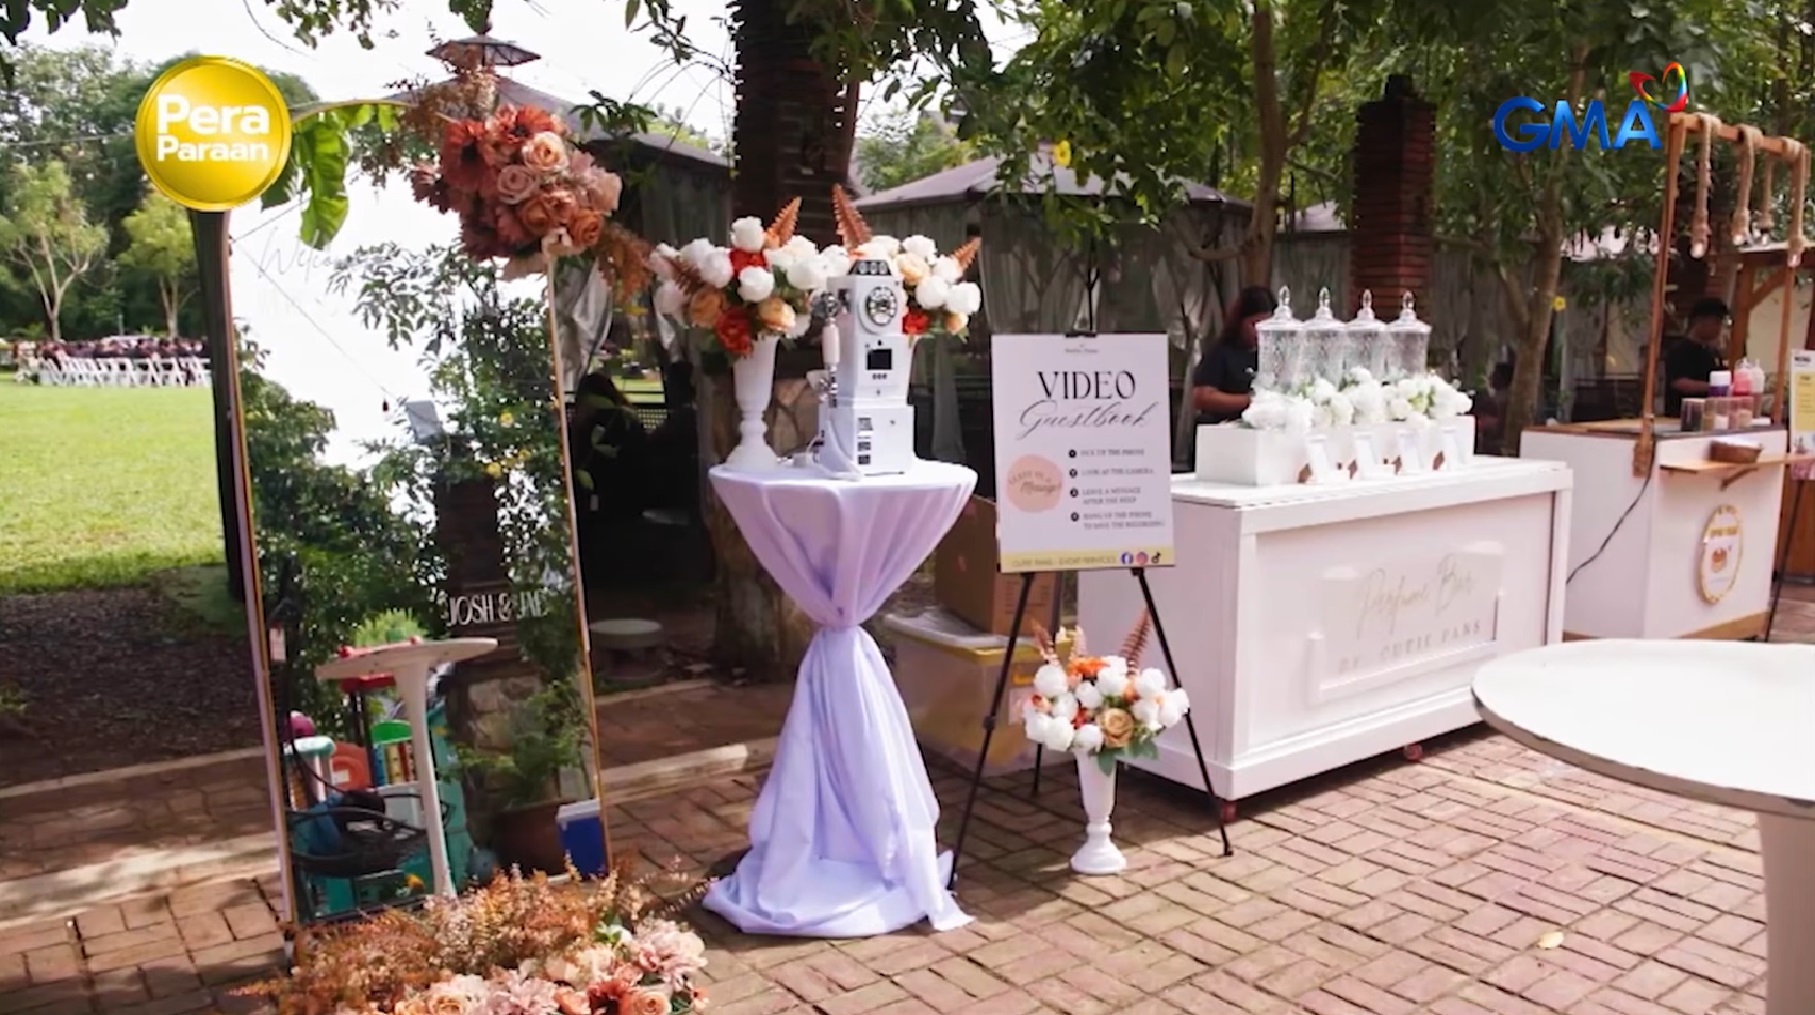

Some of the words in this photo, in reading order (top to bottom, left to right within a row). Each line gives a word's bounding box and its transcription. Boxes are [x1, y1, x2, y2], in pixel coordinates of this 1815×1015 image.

[1037, 370, 1137, 400] VIDEO
[1016, 400, 1160, 441] Guestbook
[446, 593, 495, 627] JOSH
[498, 592, 513, 623] &
